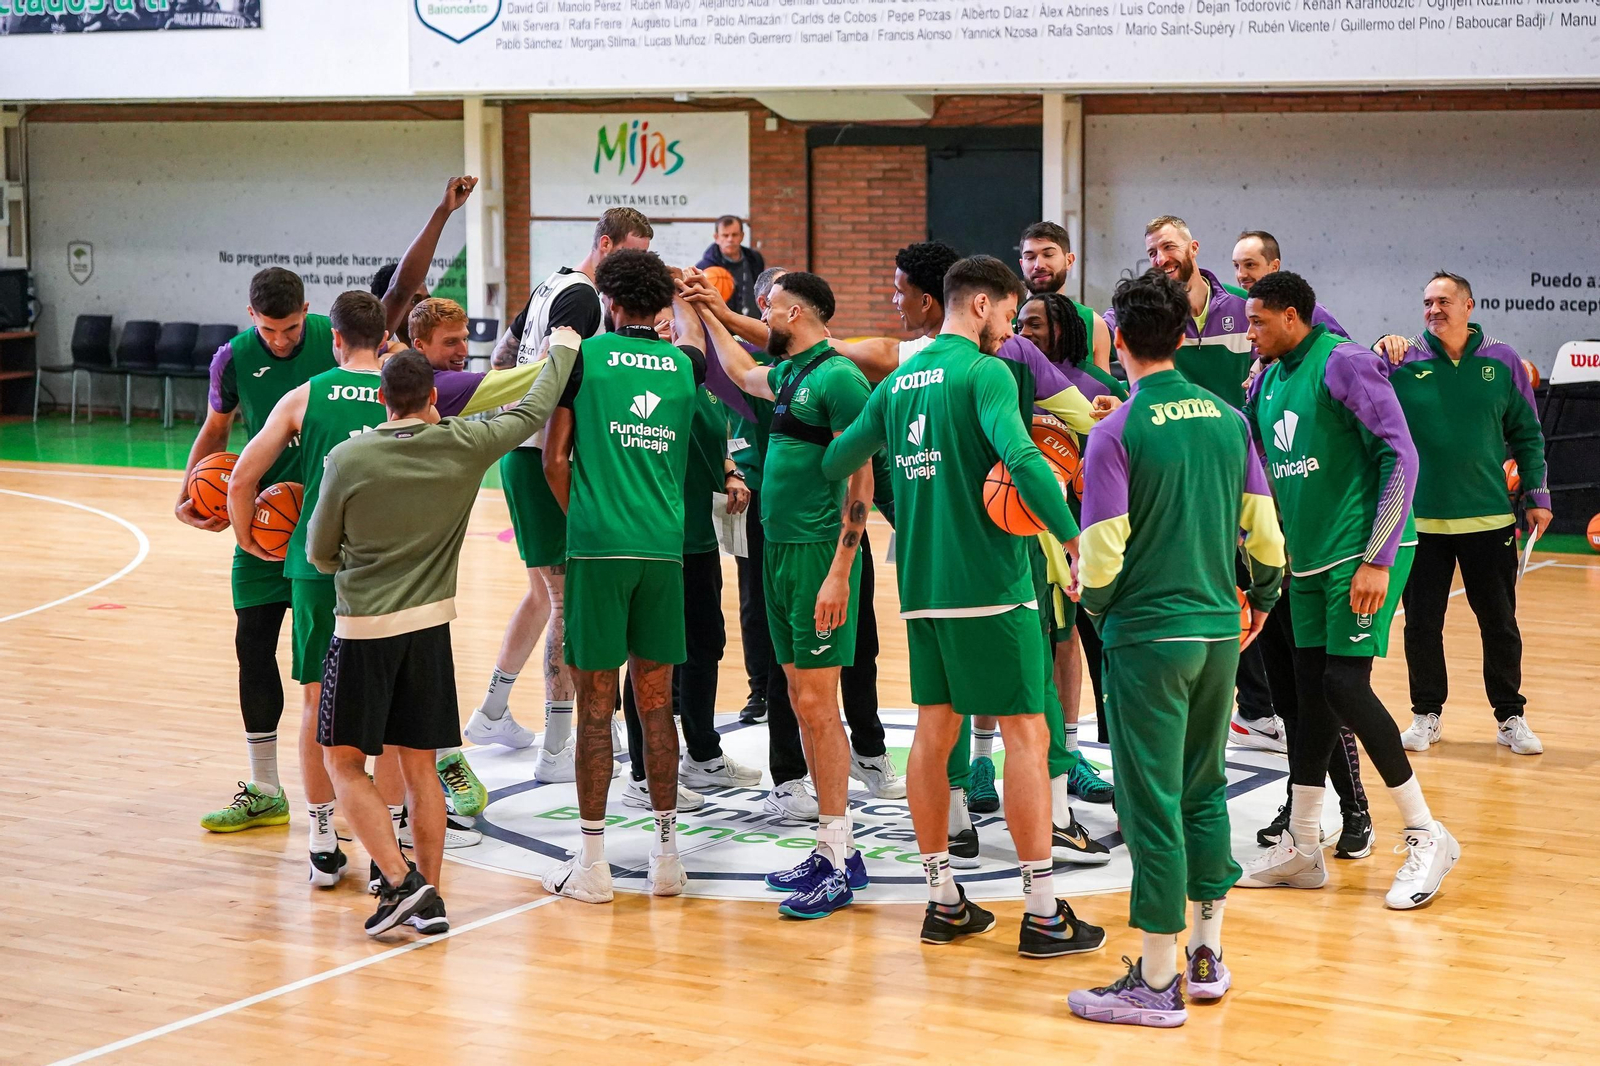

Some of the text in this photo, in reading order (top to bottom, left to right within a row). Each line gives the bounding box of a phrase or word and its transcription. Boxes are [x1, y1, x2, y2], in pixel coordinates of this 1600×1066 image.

[427, 4, 488, 15] Baloncesto
[507, 2, 533, 14] David
[536, 1, 548, 13] Gil
[523, 20, 559, 32] Servera
[631, 17, 670, 31] Augusto
[674, 17, 697, 28] Lima
[791, 12, 824, 25] Carlos
[827, 12, 840, 23] de
[844, 11, 877, 23] Cobos
[888, 10, 914, 24] Pepe
[918, 9, 951, 21] Pozas
[961, 7, 1000, 20] Alberto
[1040, 3, 1063, 17] Álex
[1066, 4, 1109, 17] Abrines
[1120, 3, 1143, 15] Luis
[1147, 1, 1184, 15] Conde
[1196, 0, 1230, 16] Dejan
[644, 35, 671, 47] Lucas
[748, 32, 791, 44] Guerrero
[800, 31, 832, 43] Ismael
[836, 30, 868, 42] Tamba
[878, 29, 914, 41] Francis
[917, 28, 952, 40] Alonso
[961, 26, 1001, 39] Yannick
[1005, 26, 1038, 38] Nzosa
[1047, 24, 1072, 36] Rafa
[1076, 23, 1113, 36] Santos
[1126, 22, 1157, 36] Mario
[1248, 20, 1285, 33] Rubén
[1288, 19, 1330, 32] Vicente
[1341, 18, 1395, 31] Guillermo
[1398, 17, 1416, 30] del
[1420, 16, 1445, 29] Pino
[1456, 15, 1513, 29] Baboucar
[1516, 13, 1546, 30] Badji
[1560, 12, 1597, 27] Manu
[594, 119, 684, 185] Mijas
[587, 194, 689, 206] AYUNTAMIENTO
[219, 251, 234, 263] No
[236, 252, 290, 267] preguntes
[293, 252, 313, 266] qué
[316, 251, 349, 267] puede
[352, 252, 382, 266] hacer
[323, 272, 343, 286] qué
[346, 271, 376, 288] pued
[1530, 272, 1582, 288] Puedo
[1480, 298, 1500, 310] no
[1504, 296, 1555, 313] puedo
[610, 421, 676, 441] Fundación
[620, 434, 669, 454] Unicaja
[1043, 435, 1070, 457] EVO
[1272, 455, 1319, 479] Unicaja
